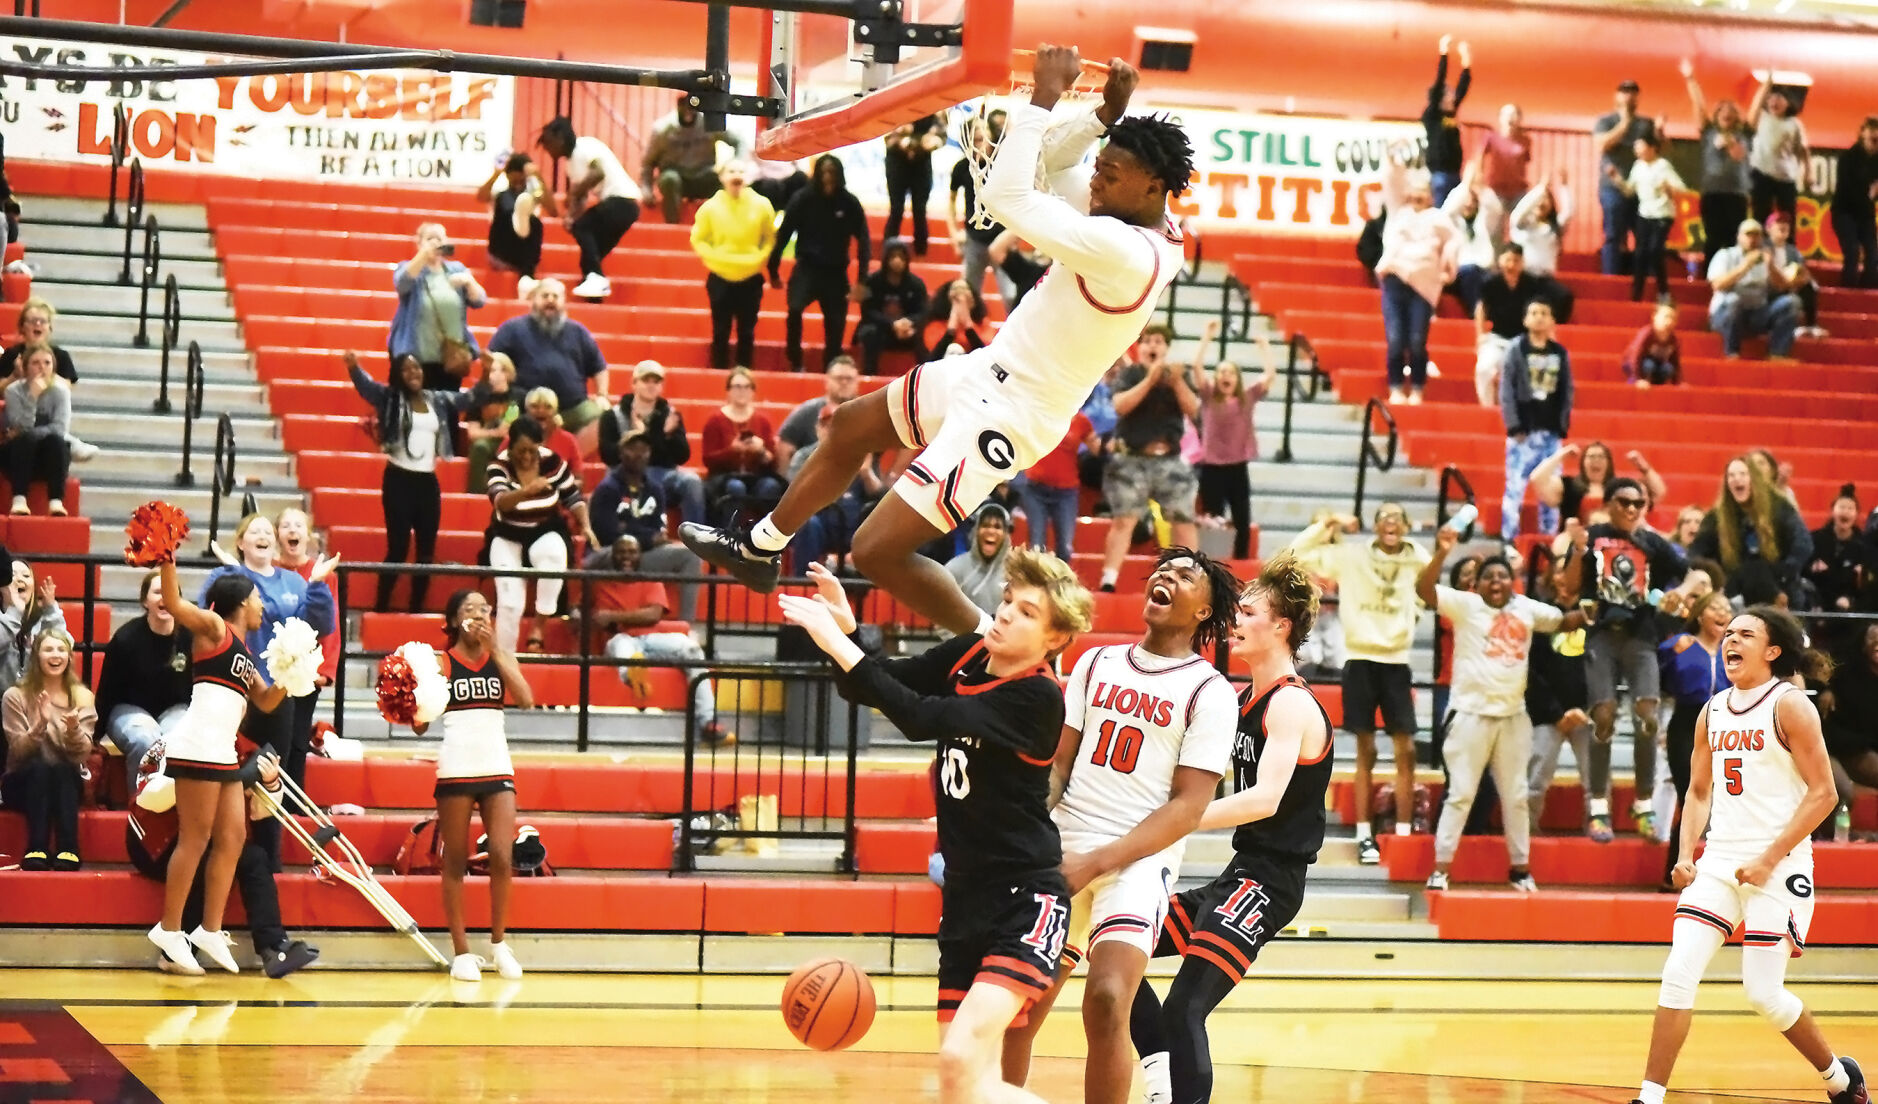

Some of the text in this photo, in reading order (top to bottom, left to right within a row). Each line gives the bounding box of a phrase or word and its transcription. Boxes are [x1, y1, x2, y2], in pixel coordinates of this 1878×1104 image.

[0, 44, 86, 94] YS
[205, 57, 498, 120] YOURSELF
[286, 126, 487, 152] THEN ALWAYS
[1212, 129, 1321, 168] STILL
[978, 430, 1015, 470] G
[453, 677, 502, 701] GHS
[1091, 682, 1174, 727] LIONS
[1090, 719, 1144, 774] 10
[1711, 729, 1765, 752] LIONS
[1724, 758, 1744, 796] 5
[1786, 874, 1812, 898] G
